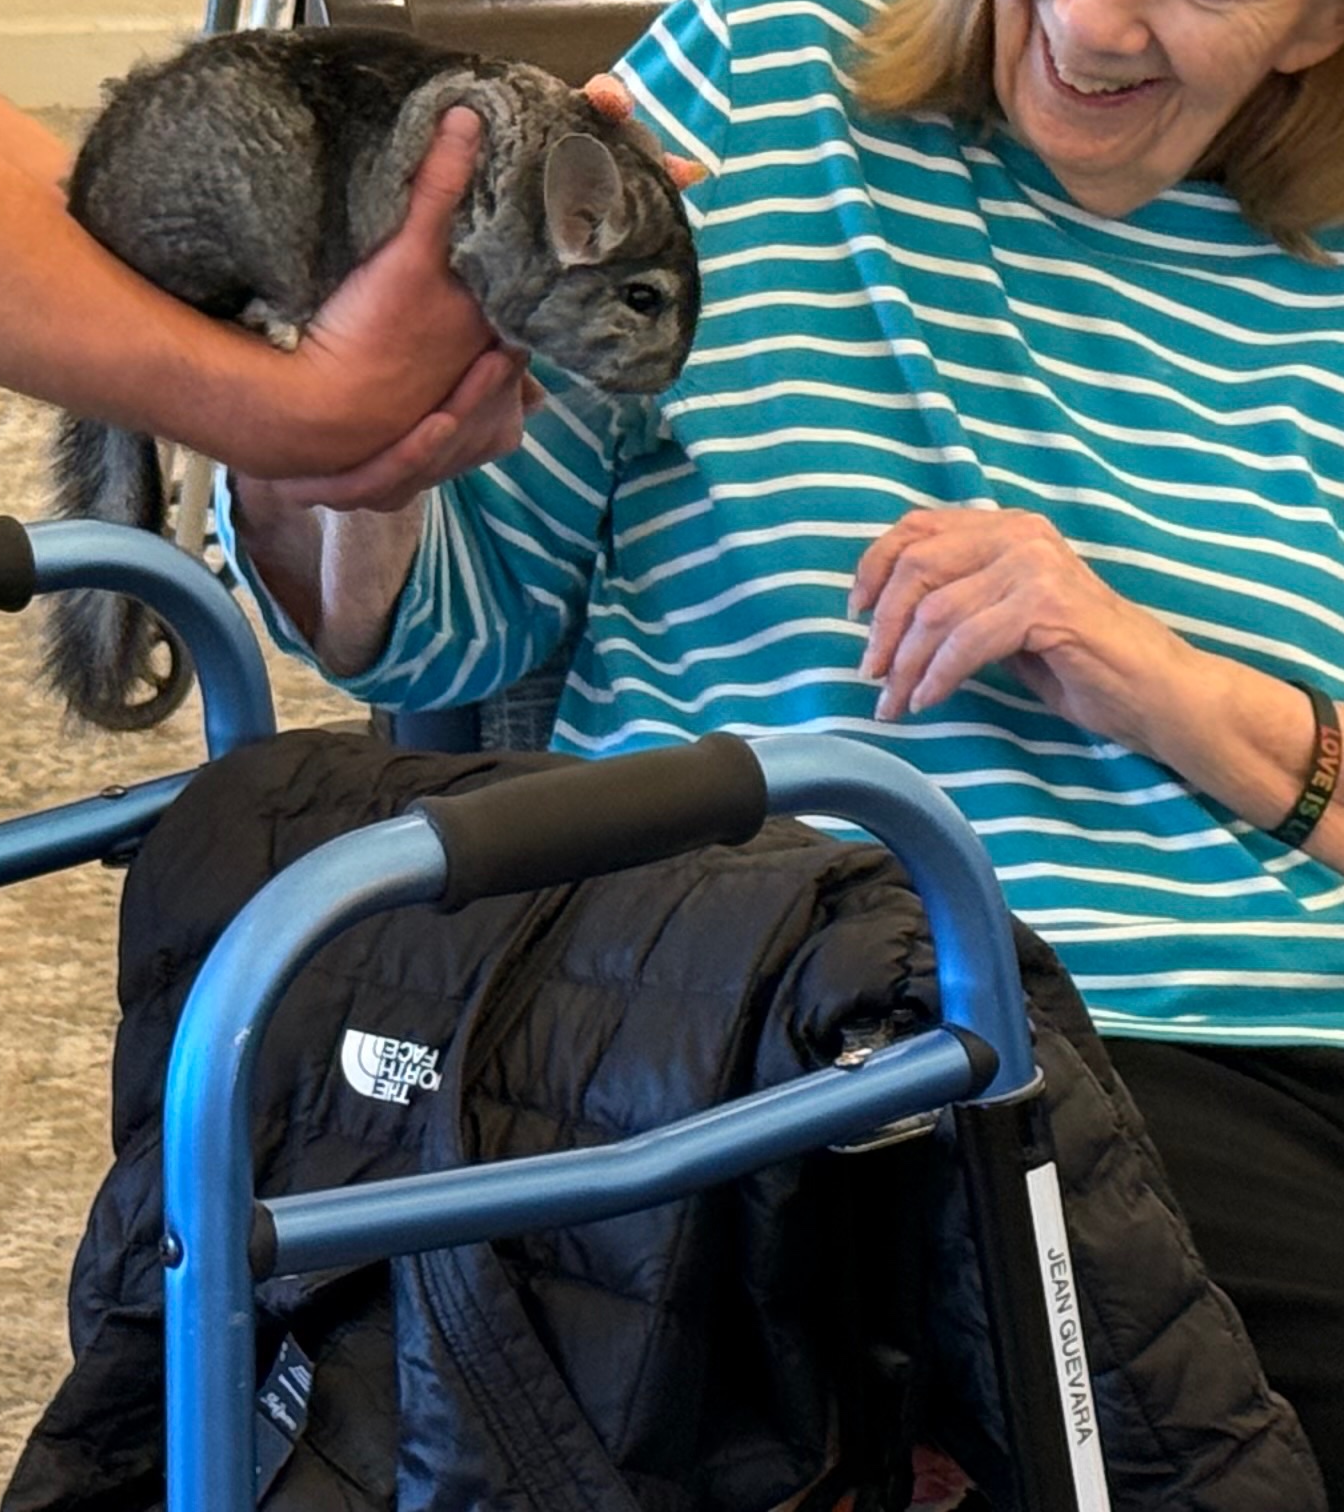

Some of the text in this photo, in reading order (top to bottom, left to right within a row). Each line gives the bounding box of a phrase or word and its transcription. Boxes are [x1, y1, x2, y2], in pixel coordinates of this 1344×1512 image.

[1299, 725, 1341, 818] LOVE IS
[383, 1038, 439, 1069] FACE
[373, 1078, 410, 1105] THE
[1047, 1247, 1093, 1446] JEAN GUEVARA
